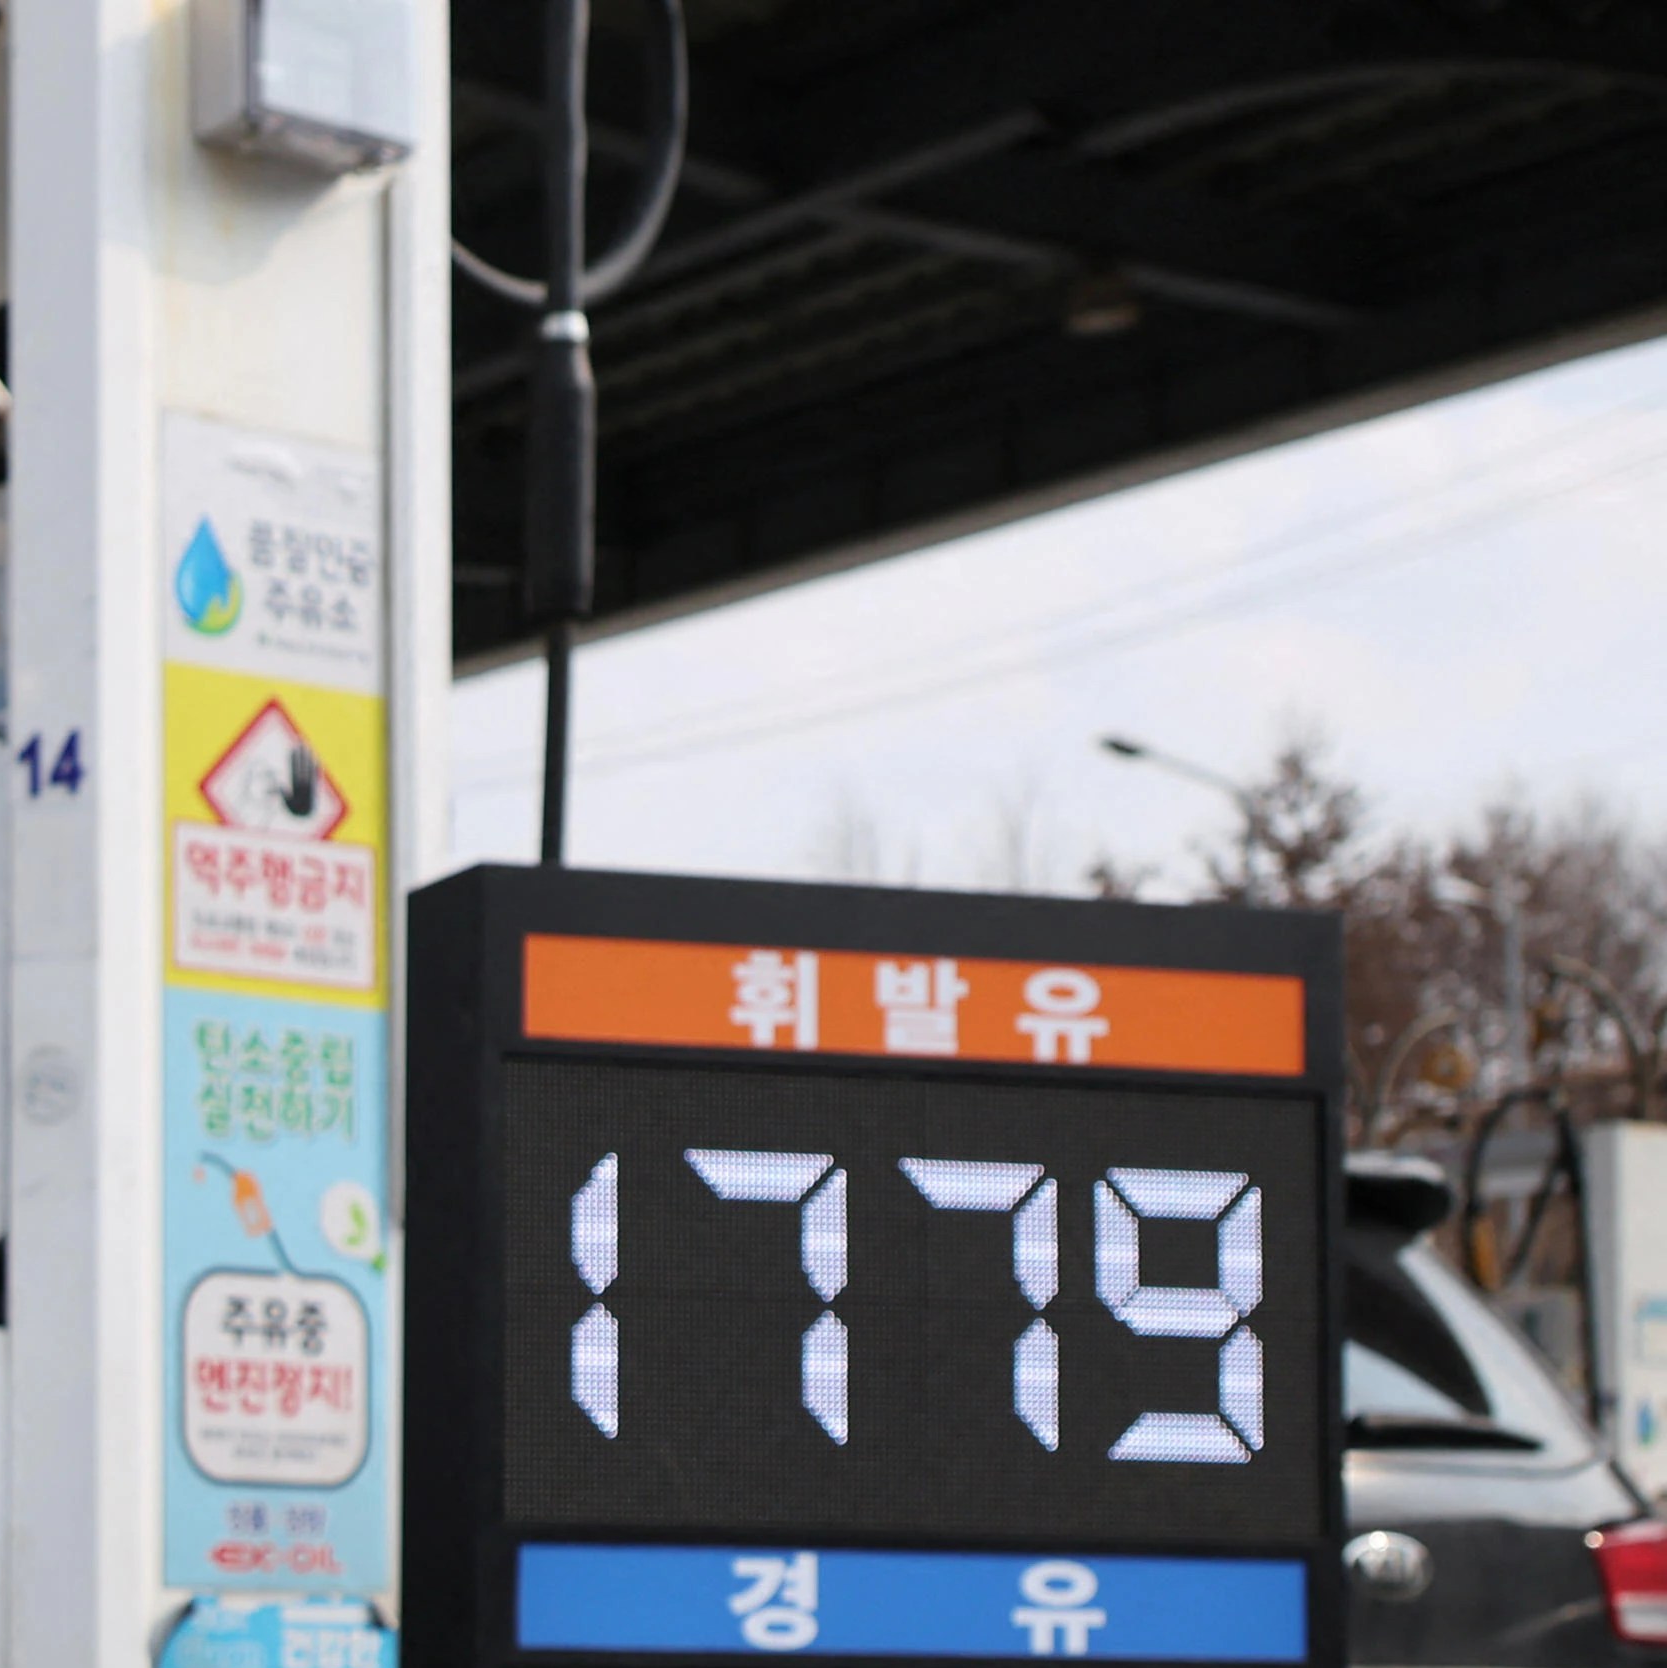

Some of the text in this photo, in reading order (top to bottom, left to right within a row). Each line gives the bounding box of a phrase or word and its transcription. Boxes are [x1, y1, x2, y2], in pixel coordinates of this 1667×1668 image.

[17, 728, 86, 799] 14
[222, 1297, 329, 1357] 주유중
[571, 1147, 1264, 1464] 1779
